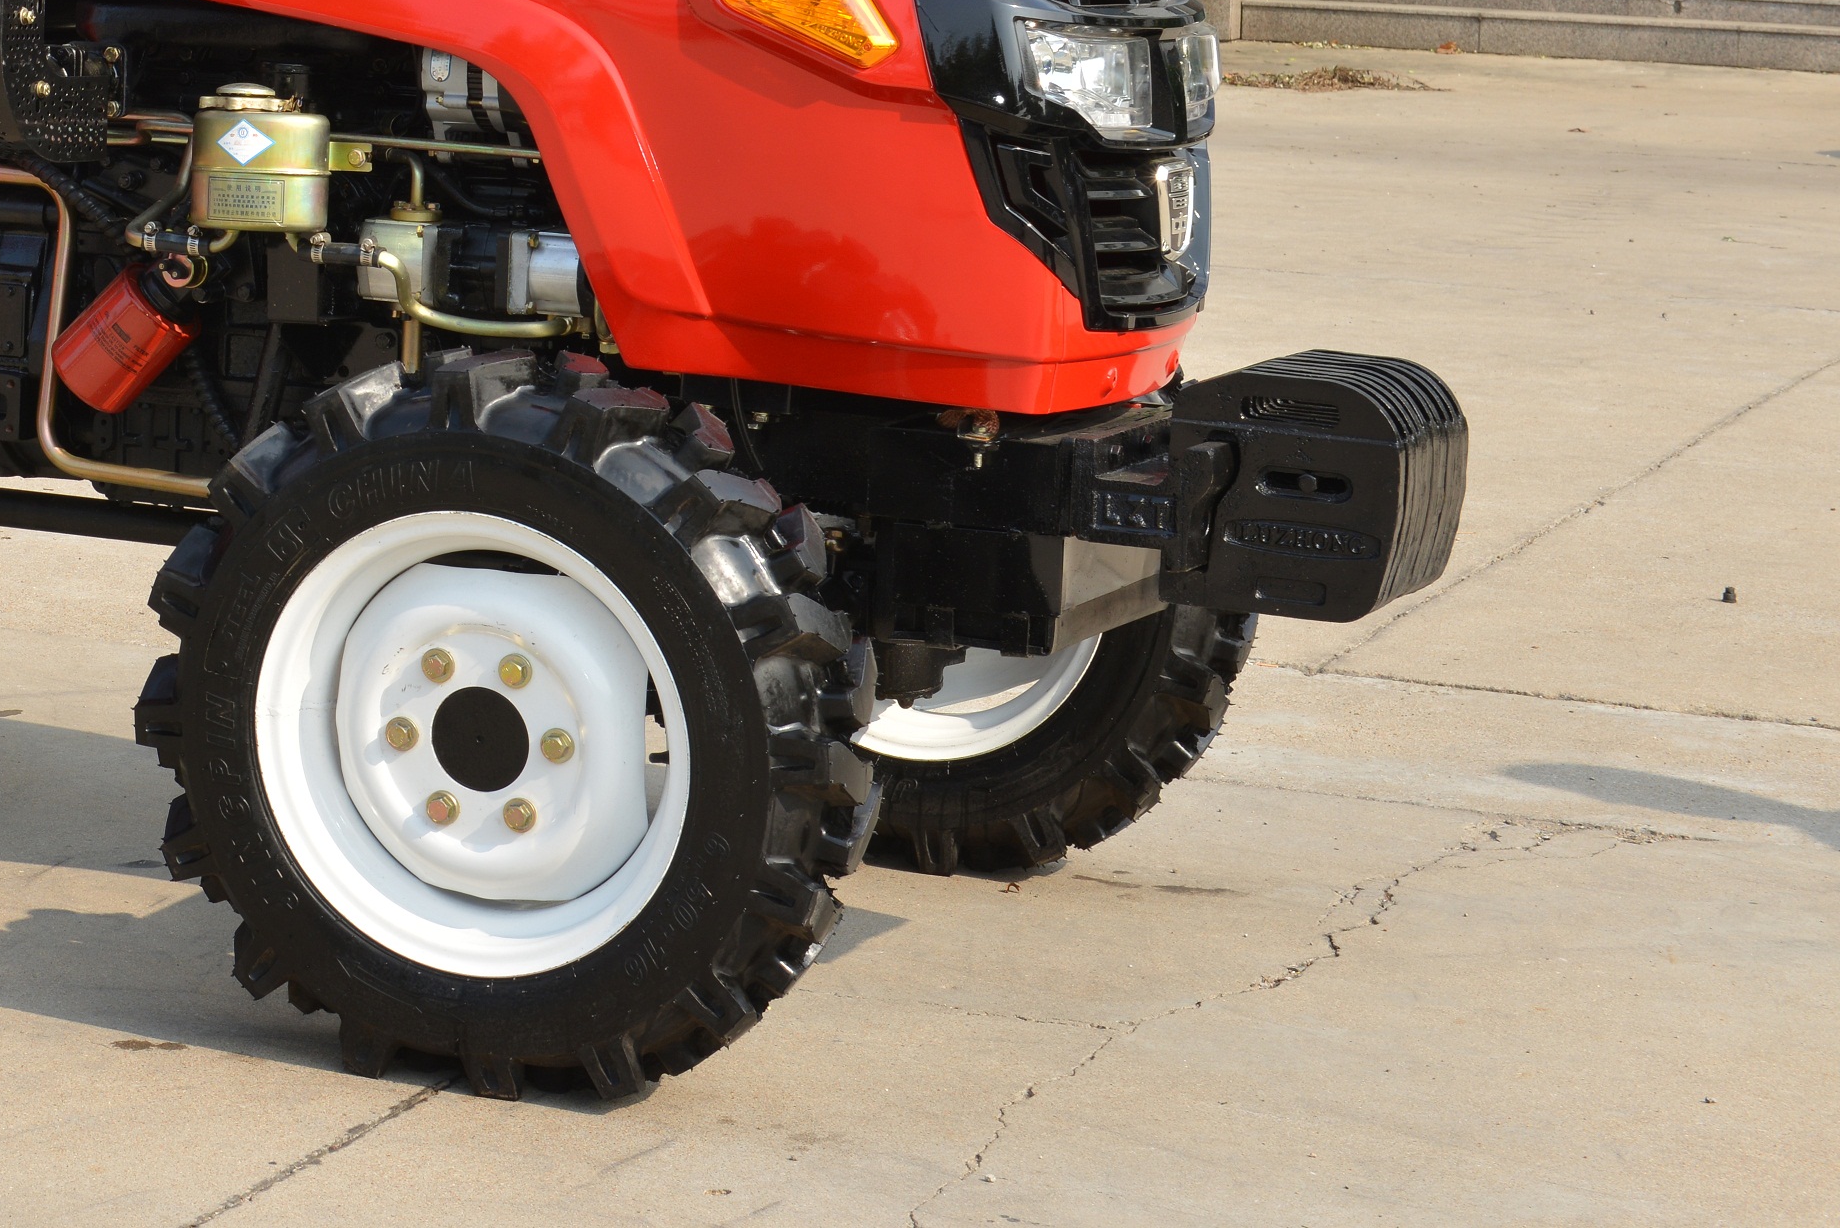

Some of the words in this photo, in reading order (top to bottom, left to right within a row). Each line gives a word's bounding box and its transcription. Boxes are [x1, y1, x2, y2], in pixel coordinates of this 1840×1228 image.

[327, 459, 475, 522] CHINA
[1238, 520, 1366, 555] LUZHONG
[624, 830, 731, 988] 6.50-16
